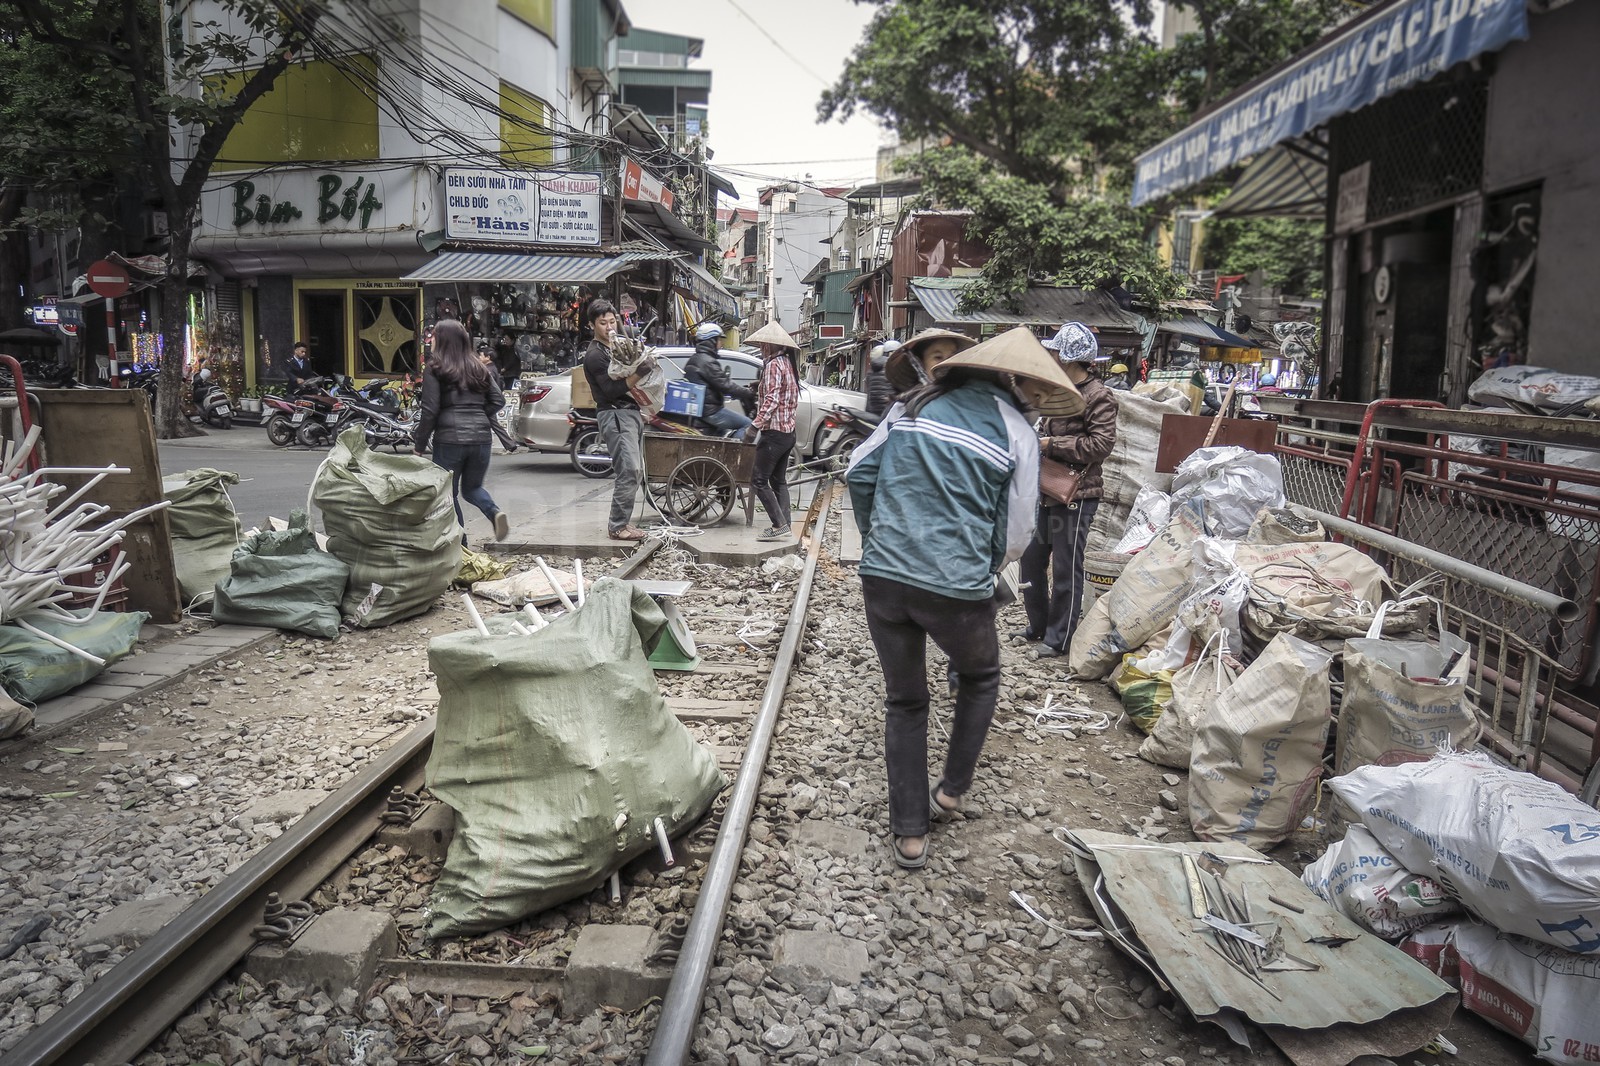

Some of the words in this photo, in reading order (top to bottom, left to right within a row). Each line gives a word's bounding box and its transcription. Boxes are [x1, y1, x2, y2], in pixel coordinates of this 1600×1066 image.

[1368, 9, 1424, 66] CÁC
[448, 173, 465, 188] ĐÈN
[467, 172, 487, 189] SƯỞI
[449, 195, 470, 208] CHLB
[472, 193, 489, 209] ĐỨC
[477, 216, 530, 231] Häns
[1477, 988, 1501, 1008] CON
[1562, 1037, 1581, 1057] 20
